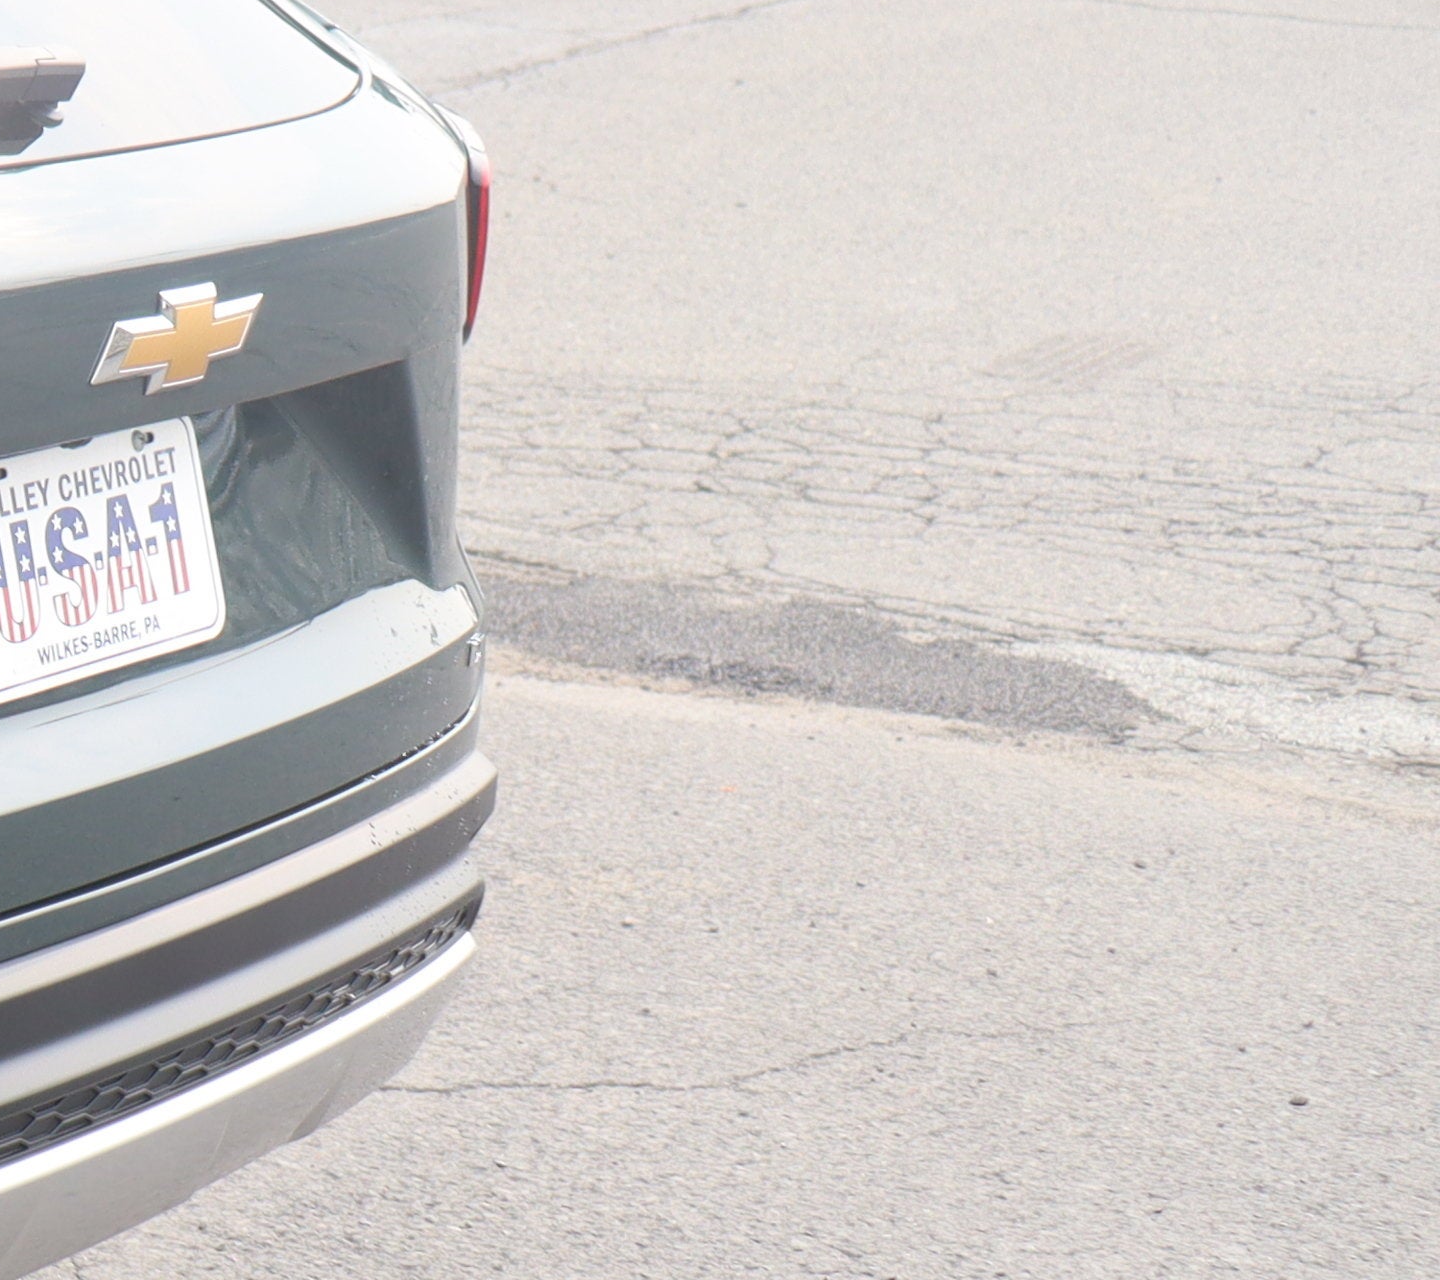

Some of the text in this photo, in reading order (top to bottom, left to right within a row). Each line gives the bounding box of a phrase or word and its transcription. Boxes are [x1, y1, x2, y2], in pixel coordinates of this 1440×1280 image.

[58, 447, 176, 502] CHEVROLET
[37, 615, 161, 665] WILKES-BARRE, PA
